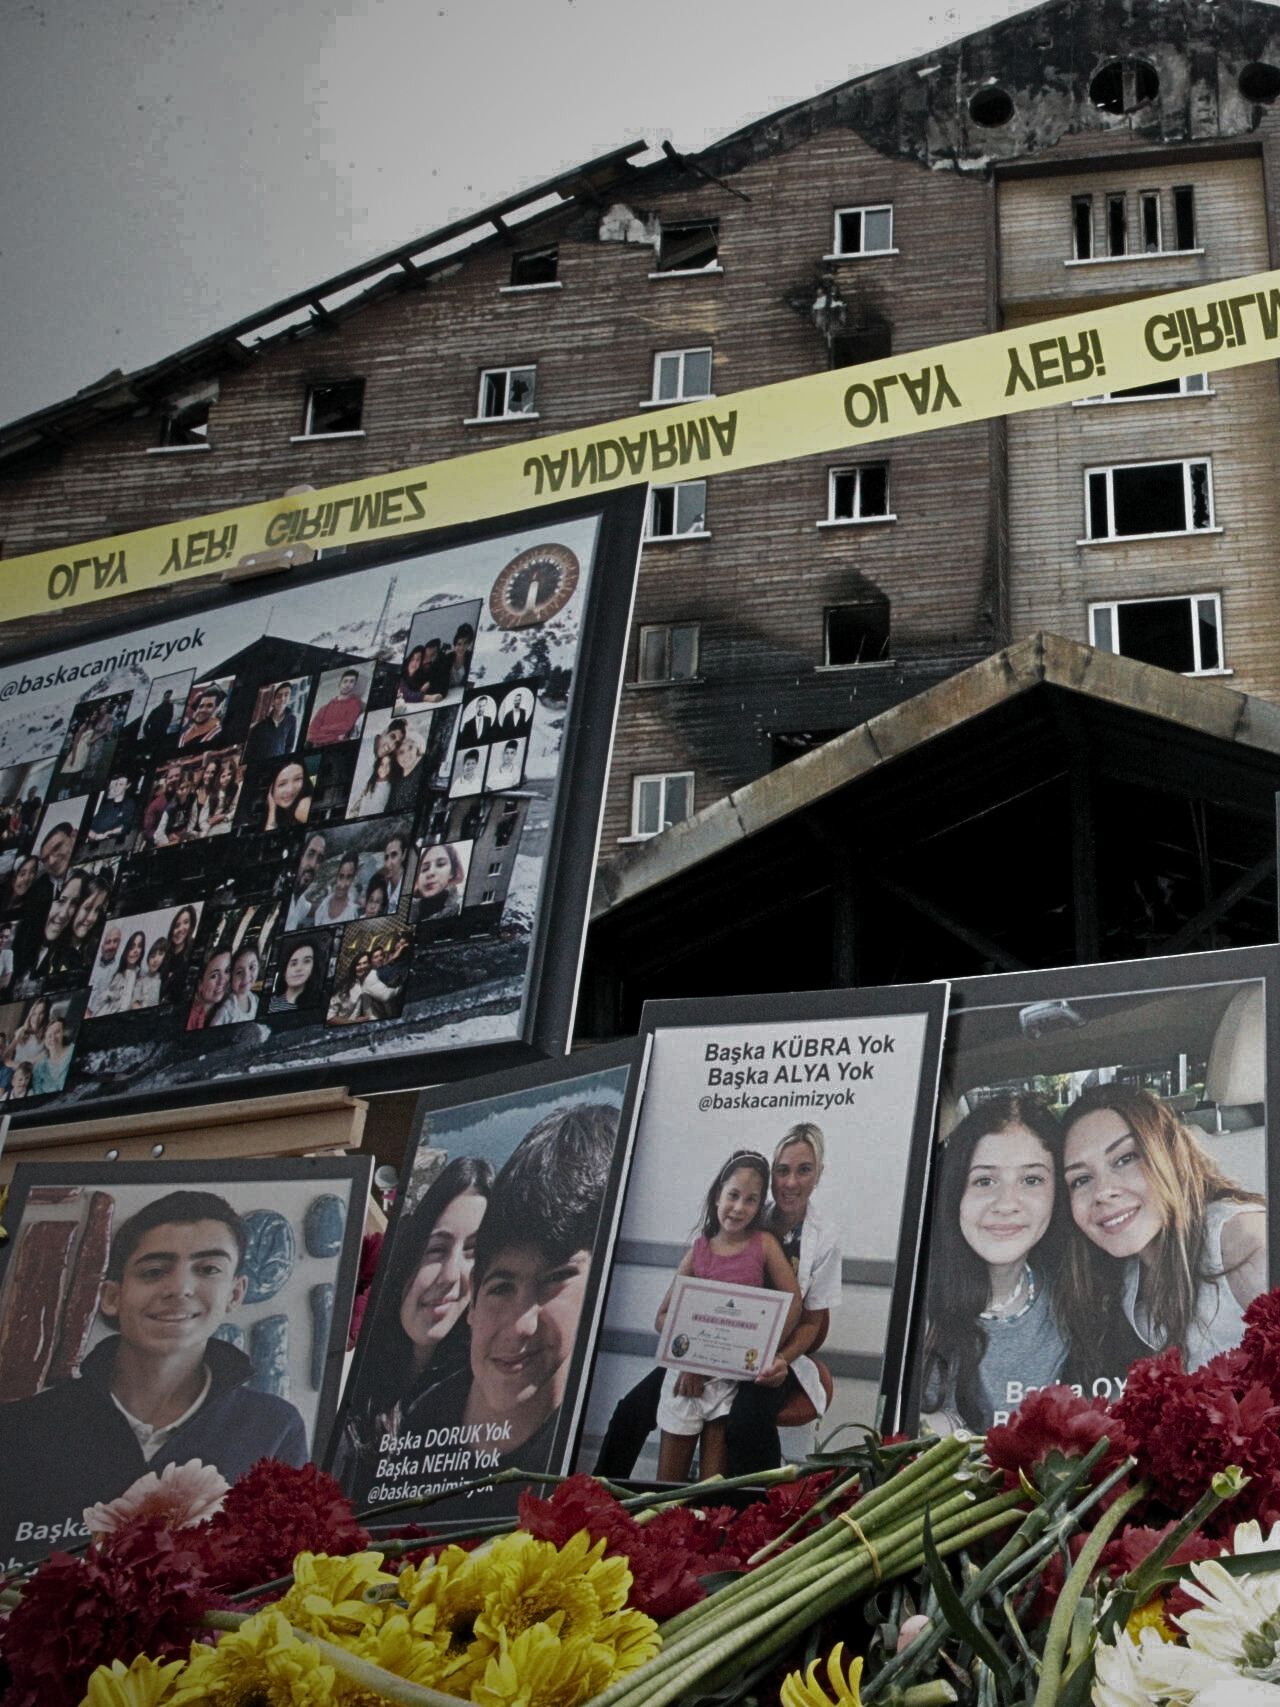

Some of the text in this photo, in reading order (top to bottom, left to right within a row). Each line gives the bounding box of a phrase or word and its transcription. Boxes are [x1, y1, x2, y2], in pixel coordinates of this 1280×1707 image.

[0, 628, 206, 701] @baskacanimizyok
[705, 1034, 896, 1065] Başka KÜBRA Yok
[708, 1061, 874, 1090] Başka ALYA Yok
[699, 1088, 856, 1111] @baskacanimizyok
[379, 1420, 513, 1455] Başka DORUK Yok
[375, 1448, 501, 1482] Başka NEHİR Yok
